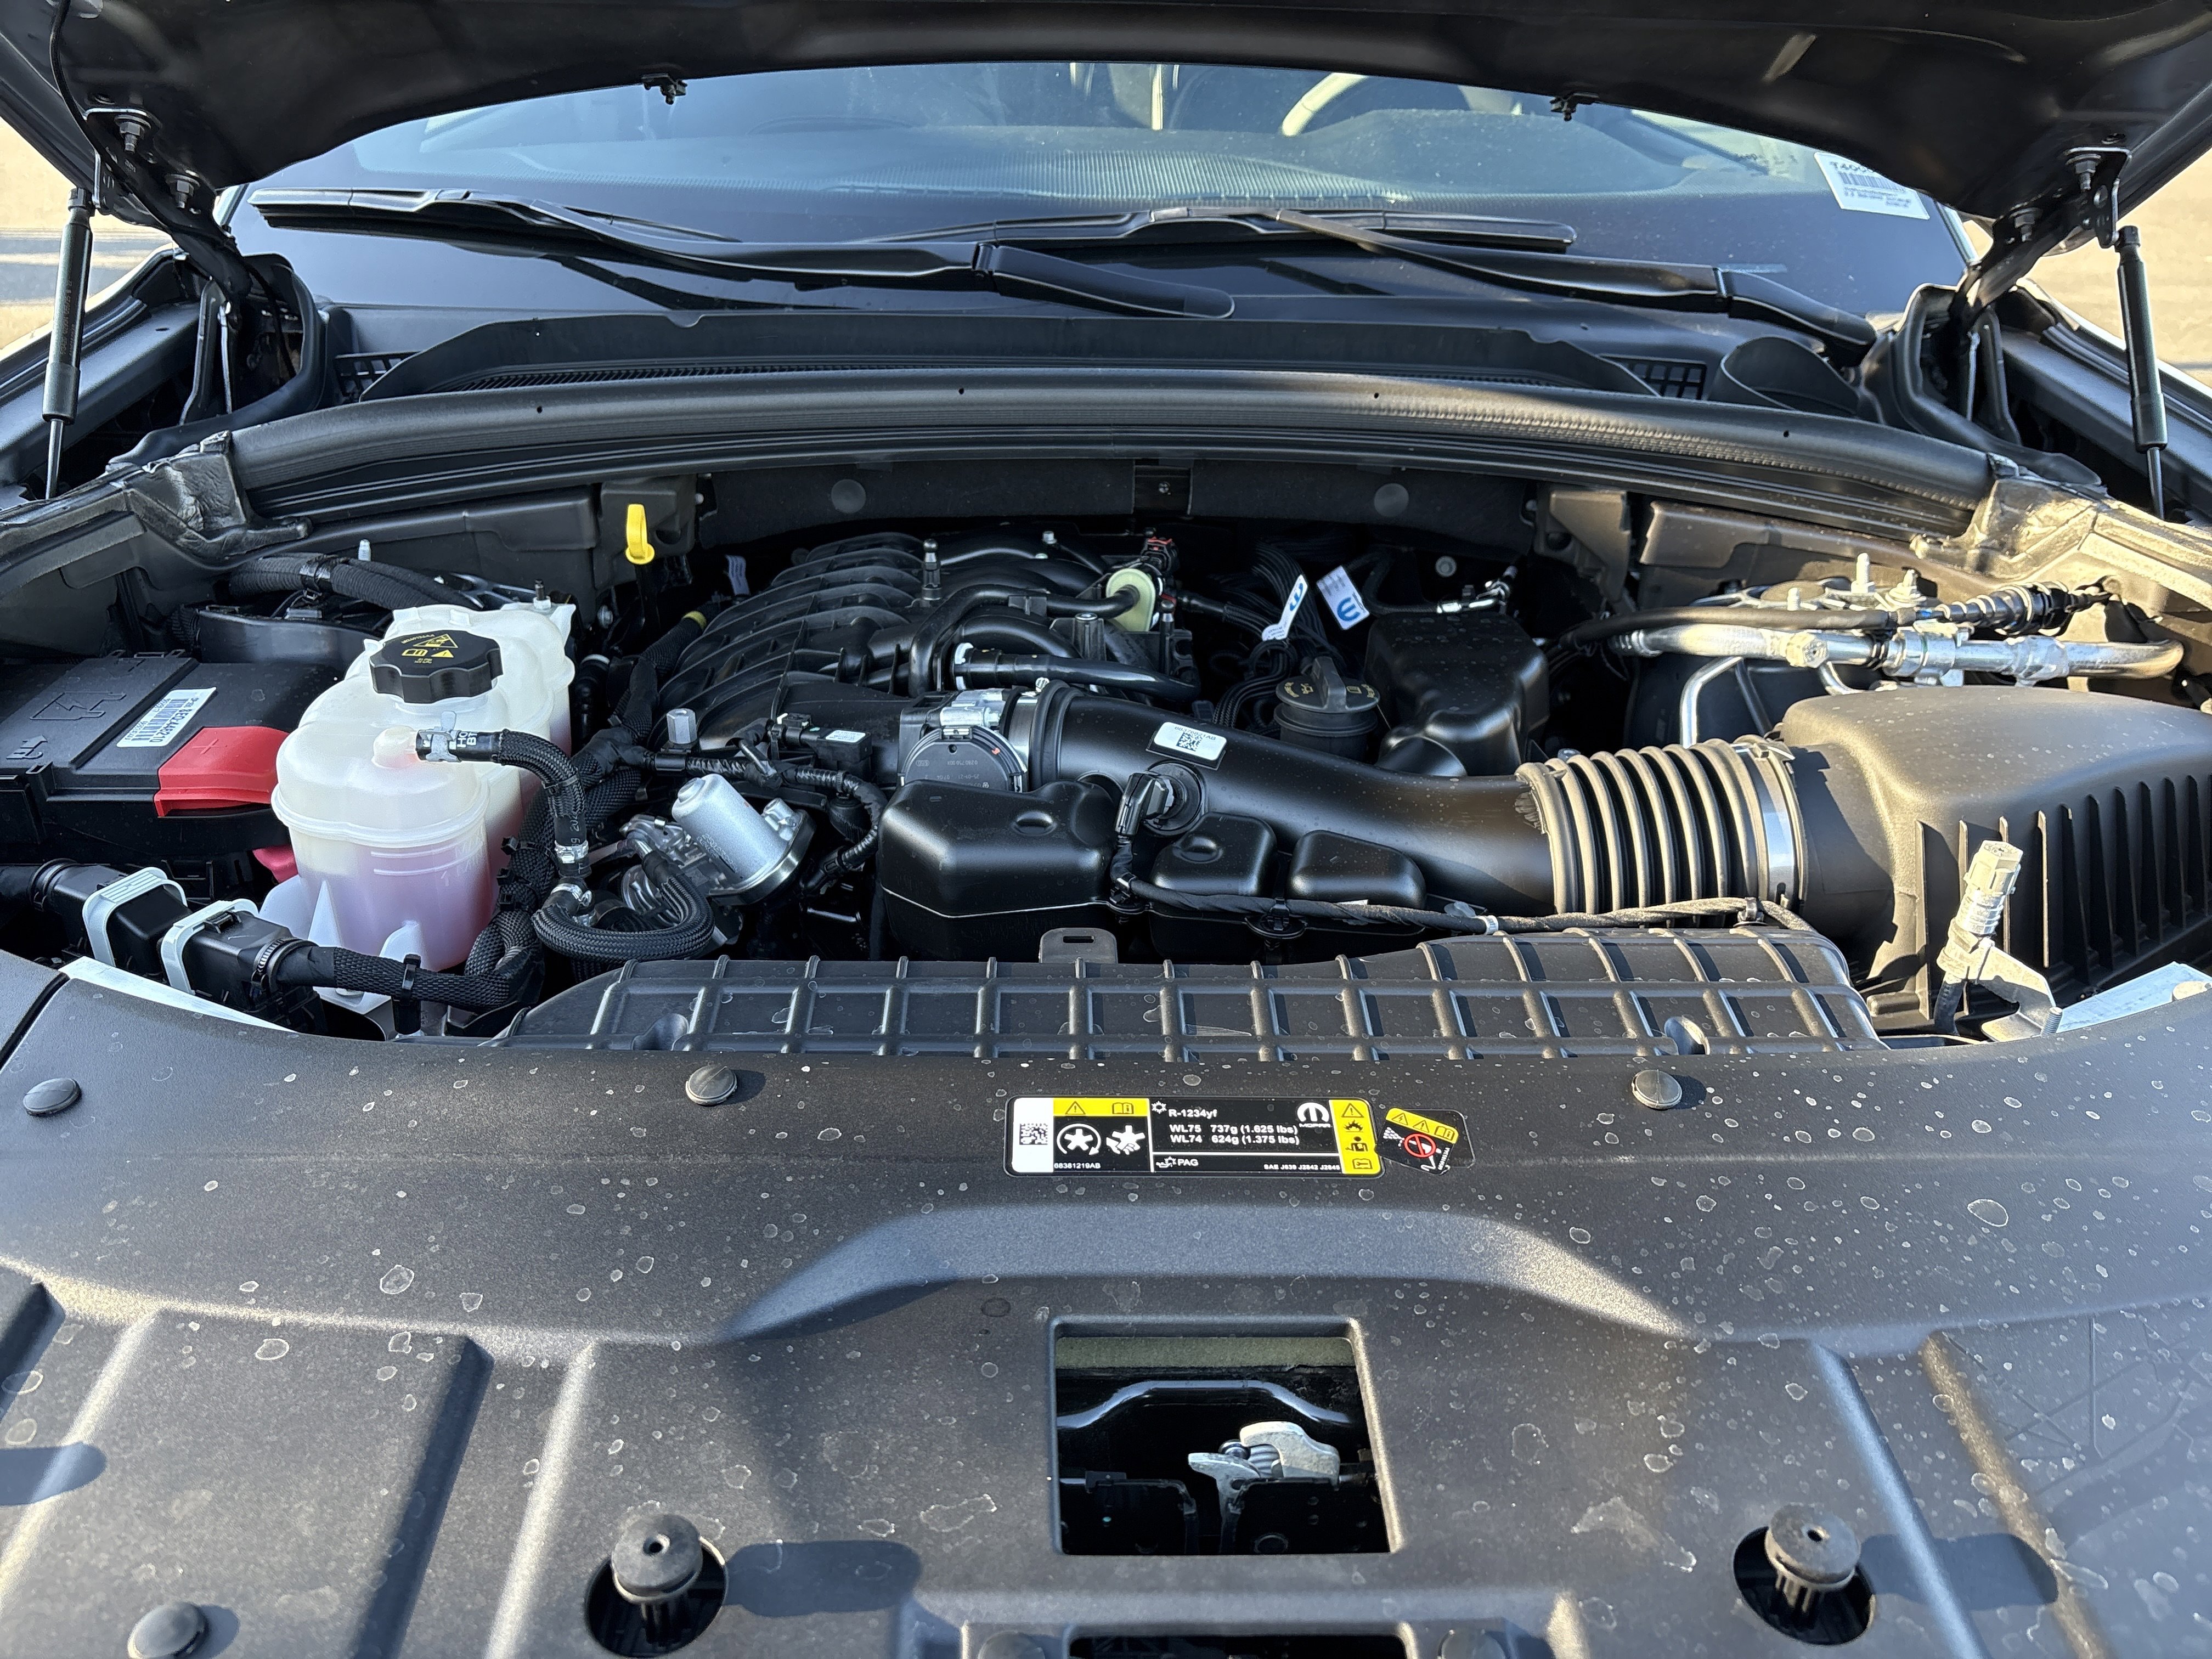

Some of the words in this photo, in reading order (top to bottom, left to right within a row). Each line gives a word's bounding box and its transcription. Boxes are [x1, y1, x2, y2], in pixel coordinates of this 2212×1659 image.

[1169, 1109, 1217, 1119] R-1234yf
[1210, 1125, 1238, 1135] 737g
[1240, 1125, 1274, 1135] (1.625
[1277, 1125, 1298, 1135] lbs)
[1170, 1135, 1203, 1143] WL74
[1211, 1135, 1239, 1144] 624g
[1242, 1135, 1276, 1145] (1.375
[1278, 1135, 1300, 1146] lbs)
